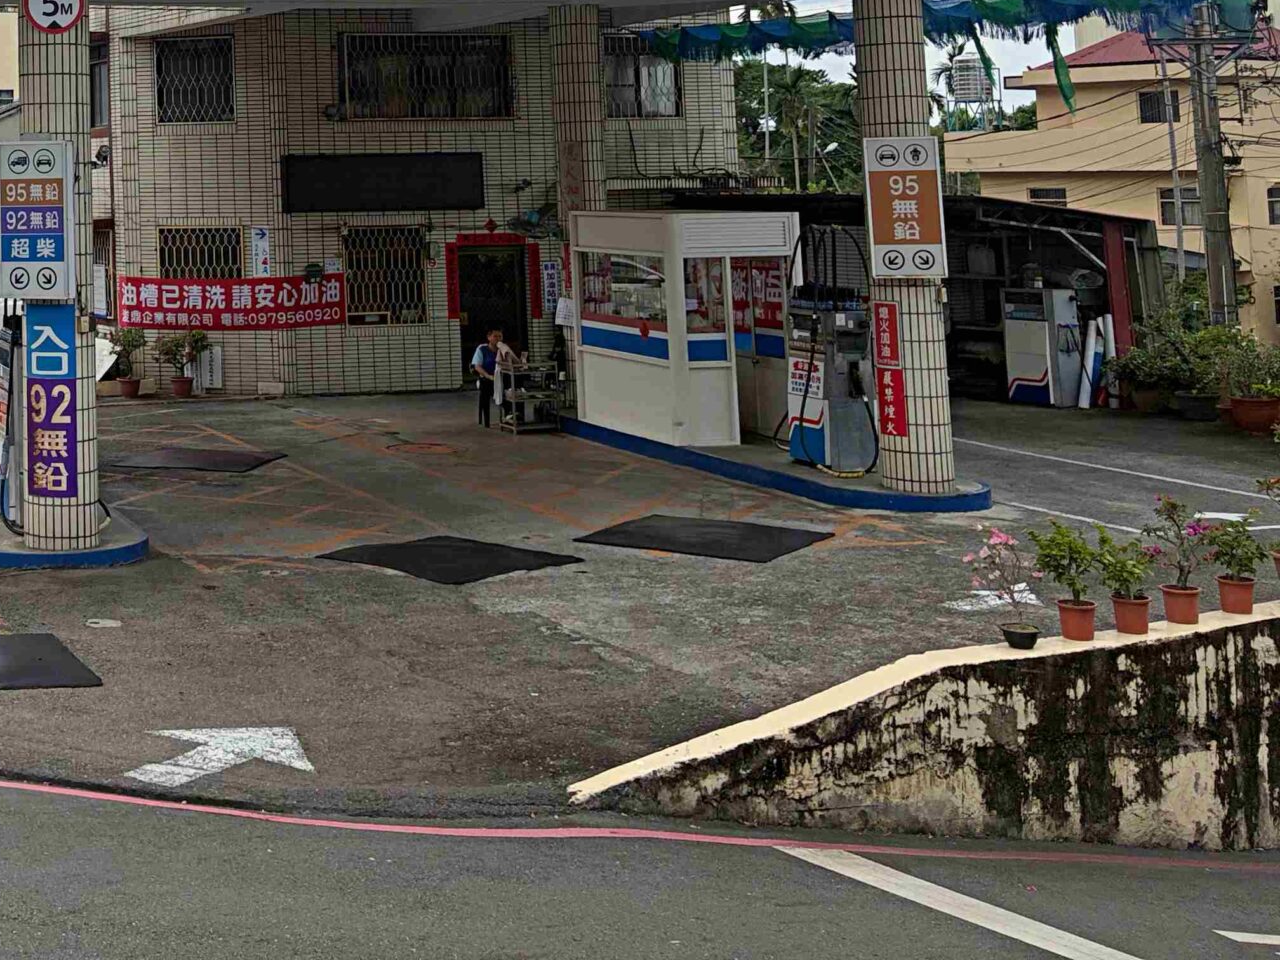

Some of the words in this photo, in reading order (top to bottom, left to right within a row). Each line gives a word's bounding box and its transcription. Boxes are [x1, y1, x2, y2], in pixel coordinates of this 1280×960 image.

[5, 183, 59, 202] 95無鉛
[889, 175, 920, 240] 95無鉛
[5, 211, 60, 230] 92無鉛
[11, 238, 56, 259] 超柴
[121, 281, 225, 309] 油槽已清洗
[231, 278, 340, 310] 請安心加油
[30, 325, 70, 376] 入口
[30, 384, 72, 491] 92無鉛
